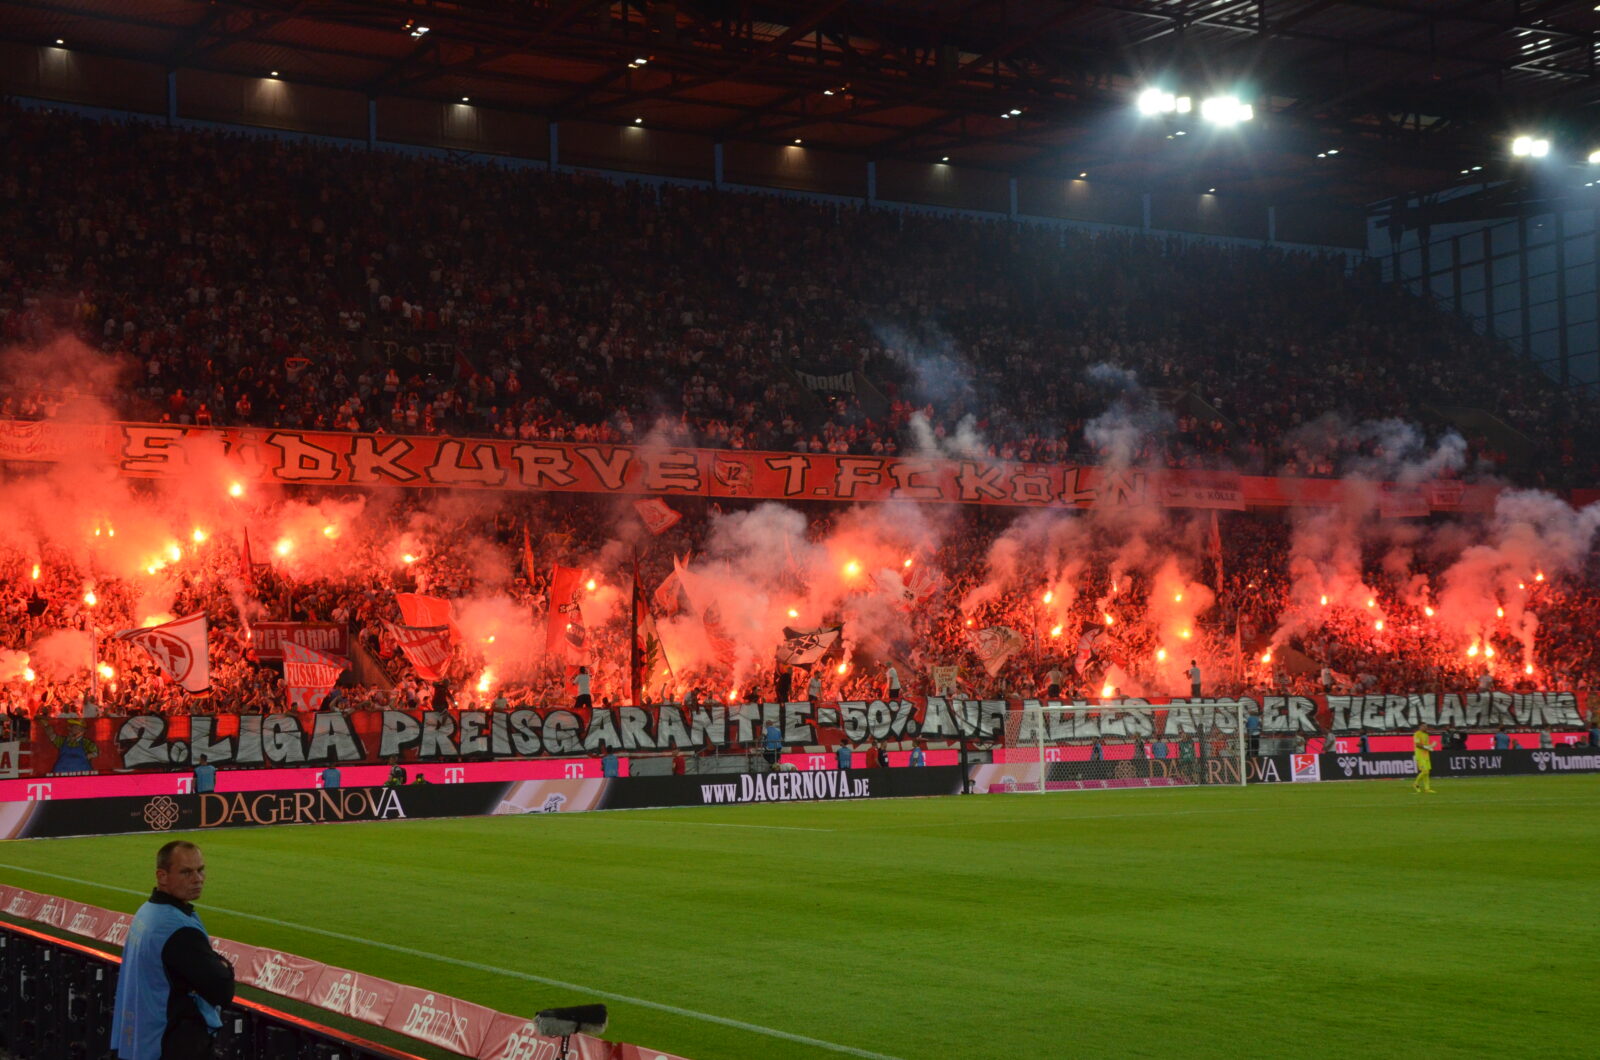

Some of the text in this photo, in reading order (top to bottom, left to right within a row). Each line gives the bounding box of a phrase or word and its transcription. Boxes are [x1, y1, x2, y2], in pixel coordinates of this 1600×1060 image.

[727, 466, 741, 480] 12
[246, 629, 288, 650] REE
[921, 696, 1006, 737] AUF
[1018, 698, 1153, 740] ALLES
[1327, 691, 1584, 730] TIERNAHRUNG
[1359, 756, 1418, 775] hummel
[1450, 756, 1502, 770] LET'S PLAY
[502, 1032, 580, 1060] DERTOR
